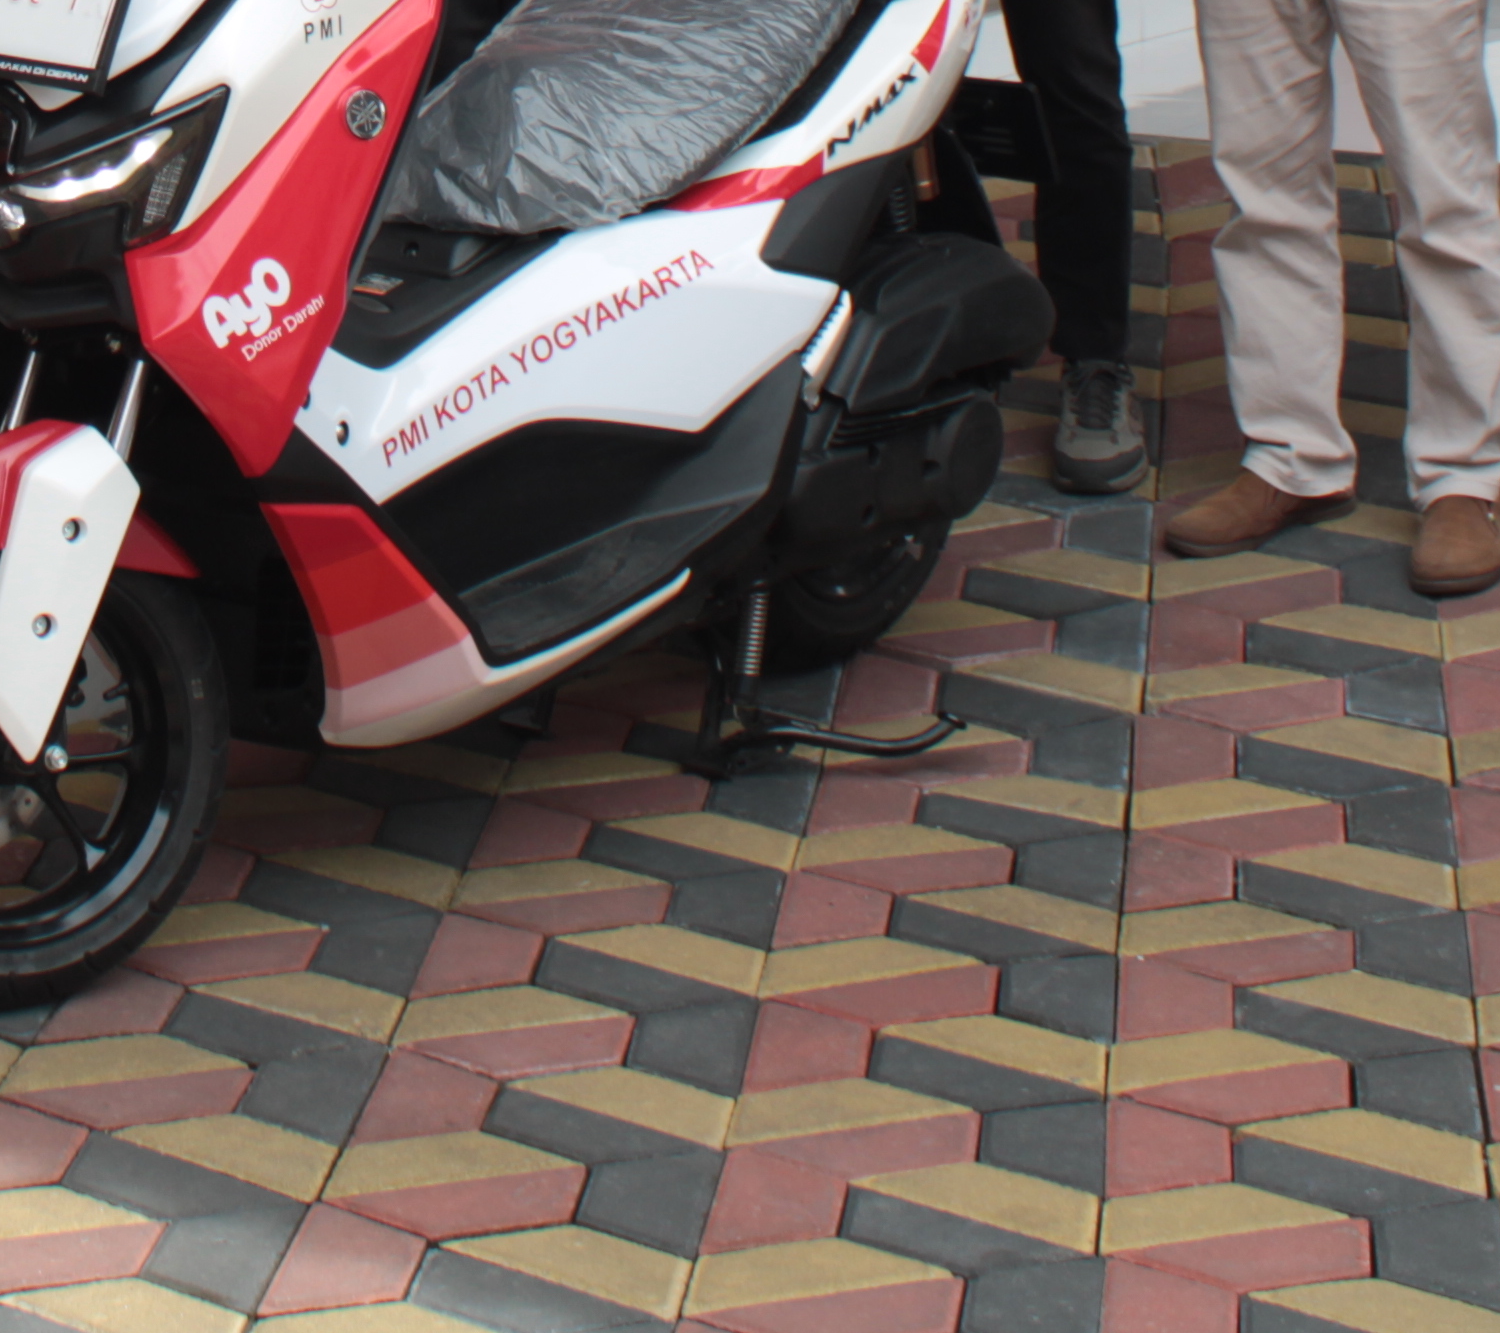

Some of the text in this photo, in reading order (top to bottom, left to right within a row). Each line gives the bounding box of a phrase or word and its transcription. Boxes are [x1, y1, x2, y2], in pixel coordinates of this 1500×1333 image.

[303, 14, 343, 44] PMI
[46, 68, 89, 84] DEPAN
[241, 326, 283, 362] Donor
[380, 248, 716, 468] PMI KOTA YOGYAKARTA
